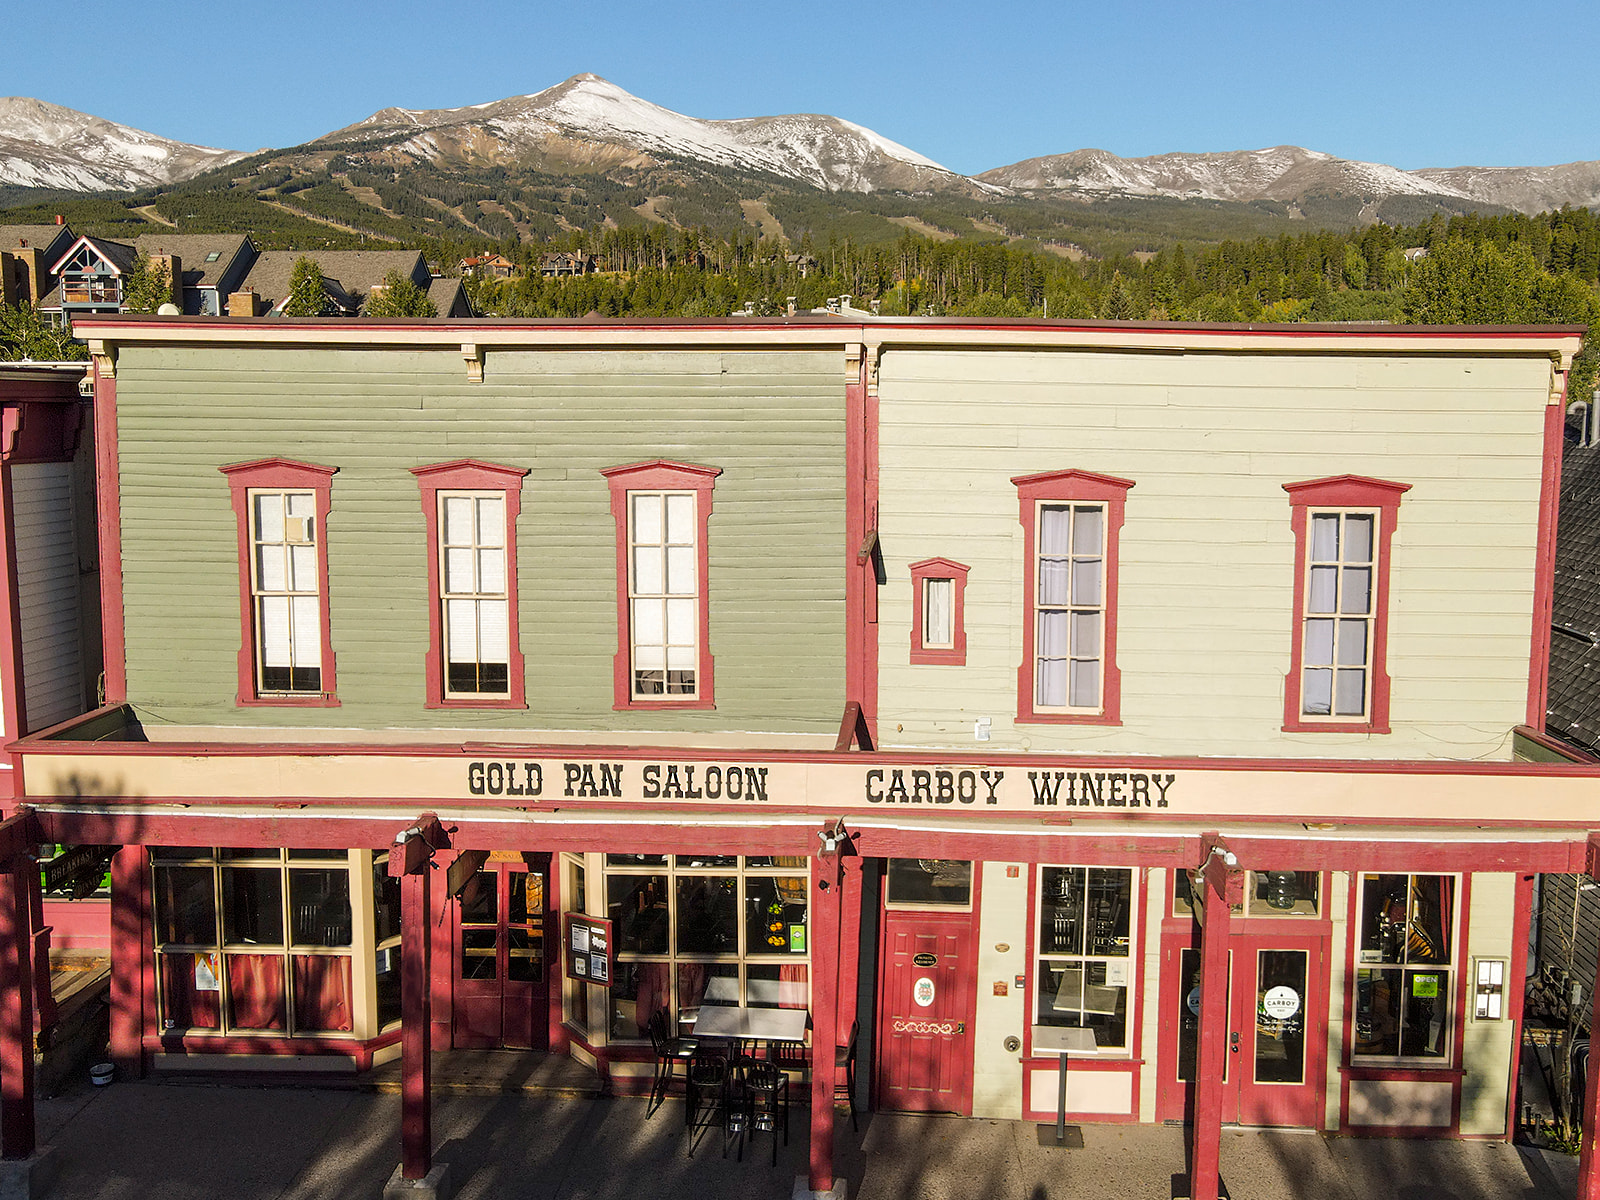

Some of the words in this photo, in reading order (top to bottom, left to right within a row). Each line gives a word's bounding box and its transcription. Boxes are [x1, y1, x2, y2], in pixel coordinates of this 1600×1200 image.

[468, 762, 544, 796] GOLD
[563, 762, 624, 798] PAN
[642, 764, 769, 802] SALOON
[865, 769, 1005, 805] CARBOY
[1027, 771, 1176, 808] WINERY
[51, 848, 93, 883] BREAKFAST
